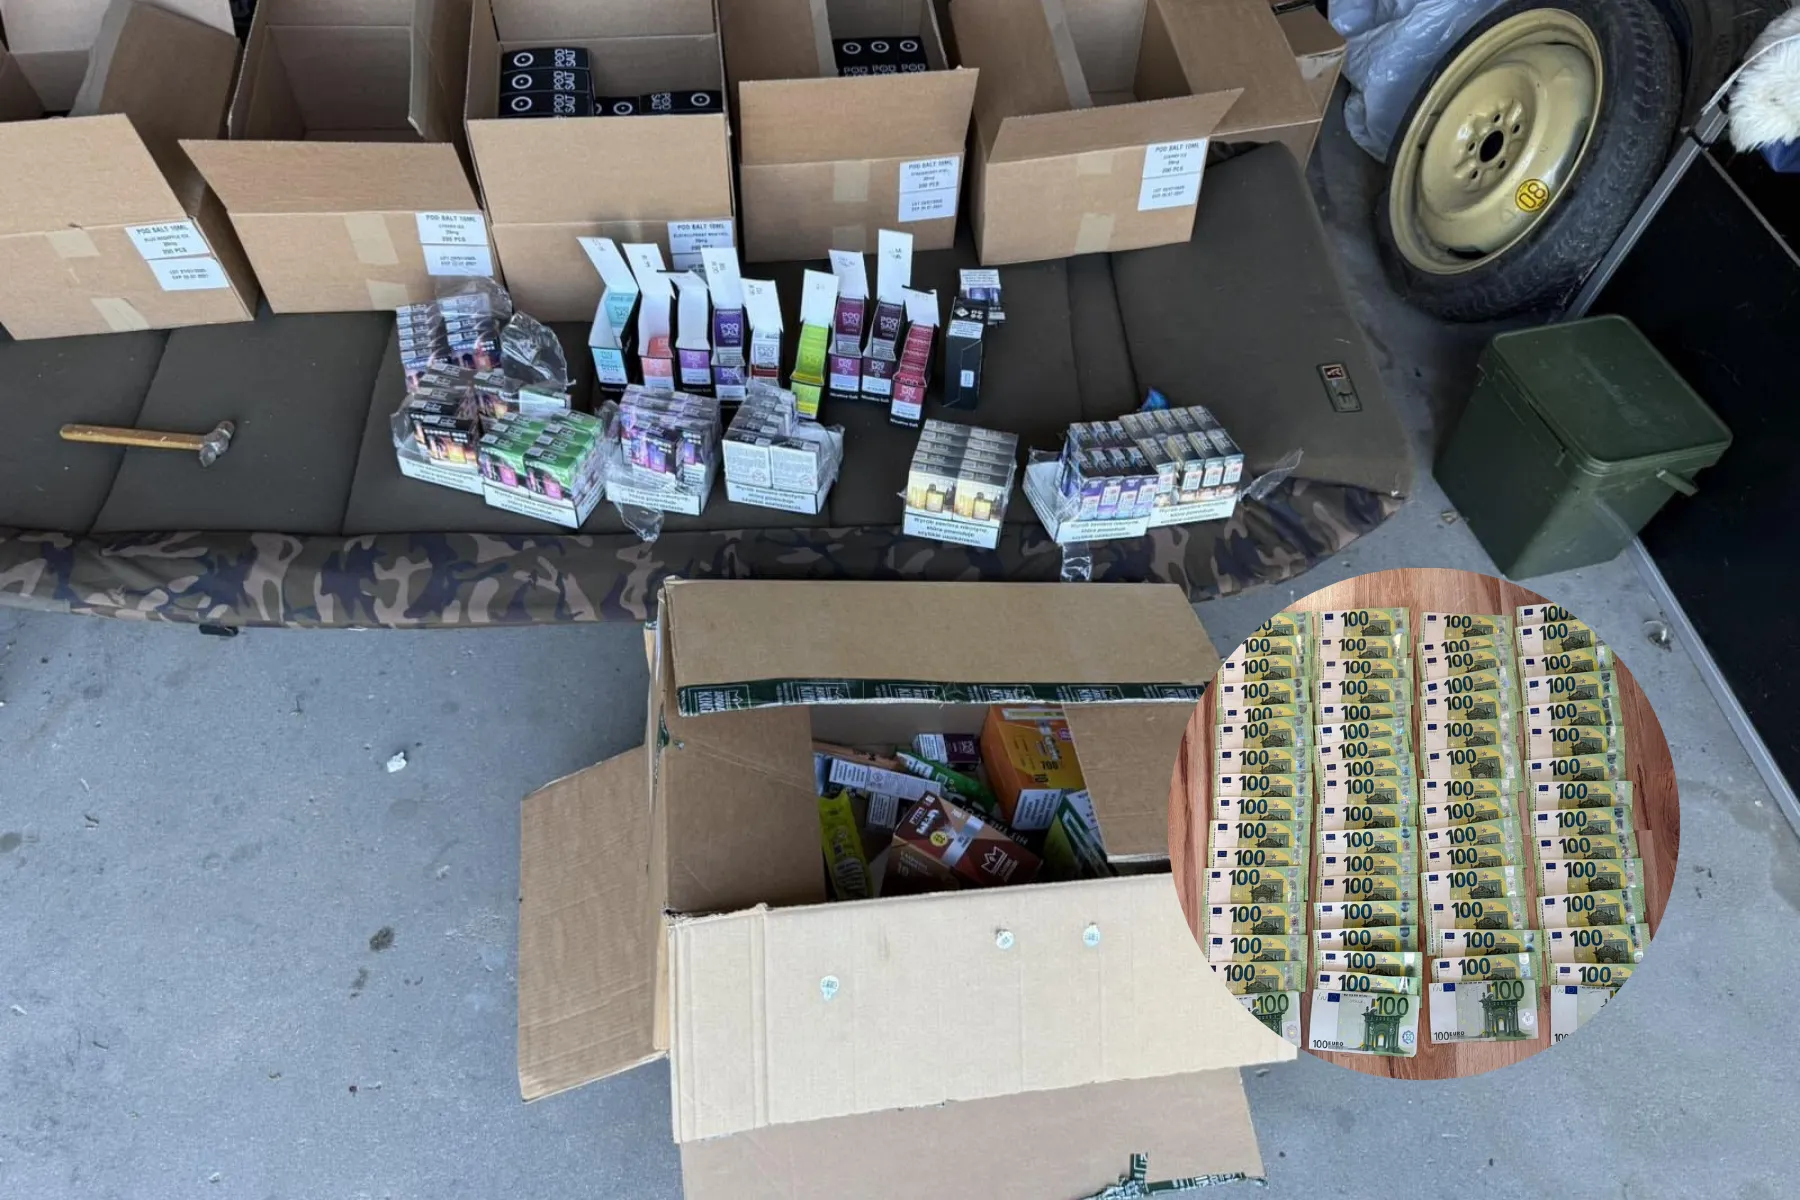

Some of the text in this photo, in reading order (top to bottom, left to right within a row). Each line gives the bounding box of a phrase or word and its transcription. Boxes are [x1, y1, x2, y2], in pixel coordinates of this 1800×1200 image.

[554, 48, 565, 67] POD
[565, 49, 576, 67] SALT
[553, 70, 564, 90] POD
[564, 71, 575, 90] SALT
[553, 94, 565, 113] POD
[565, 95, 576, 113] SALT
[1340, 611, 1369, 627] 100
[1444, 615, 1472, 628] 100
[1540, 605, 1568, 622] 100
[1539, 623, 1568, 640] 100
[1242, 638, 1270, 653] 100
[1338, 638, 1366, 651] 100
[1441, 640, 1470, 653] 100
[1241, 658, 1270, 675] 100
[1343, 660, 1371, 674] 100
[1444, 653, 1474, 668] 100
[1541, 654, 1570, 670] 100
[1241, 682, 1269, 699] 100
[1339, 680, 1368, 695] 100
[1444, 676, 1473, 694] 100
[1546, 676, 1575, 693] 100
[1444, 695, 1473, 710] 100
[1244, 707, 1273, 722] 100
[1341, 705, 1370, 721] 100
[1547, 703, 1577, 720] 100
[1240, 722, 1269, 739] 100
[1340, 723, 1369, 739] 100
[1444, 722, 1473, 738] 100
[1549, 727, 1580, 743] 100
[1239, 750, 1269, 766] 100
[1338, 741, 1368, 758] 100
[1447, 749, 1476, 765] 100
[1344, 761, 1374, 776] 100
[1549, 758, 1580, 775] 100
[1239, 775, 1270, 792] 100
[1345, 779, 1374, 795] 100
[1444, 780, 1474, 796] 100
[1556, 783, 1588, 799] 100
[1236, 799, 1268, 815] 100
[1343, 806, 1373, 822] 100
[1444, 802, 1474, 819] 100
[1556, 810, 1587, 827] 100
[1236, 822, 1267, 839] 100
[1343, 831, 1373, 847] 100
[1446, 827, 1476, 844] 100
[1559, 838, 1590, 853] 100
[1234, 850, 1265, 866] 100
[1344, 856, 1373, 872] 100
[1446, 848, 1477, 865] 100
[1229, 869, 1260, 886] 100
[1564, 861, 1596, 878] 100
[1342, 878, 1373, 894] 100
[1446, 871, 1477, 888] 100
[1341, 903, 1372, 920] 100
[1451, 902, 1483, 918] 100
[1563, 895, 1595, 912] 100
[1230, 905, 1261, 923] 100
[1230, 937, 1262, 954] 100
[1339, 930, 1371, 946] 100
[1463, 931, 1495, 948] 100
[1570, 929, 1603, 947] 100
[1344, 952, 1376, 969] 100
[1458, 958, 1490, 975] 100
[1224, 964, 1255, 982] 100
[1579, 966, 1611, 982] 100
[1338, 974, 1370, 991] 100
[1492, 981, 1524, 999] 100
[1257, 994, 1289, 1013] 100
[1376, 997, 1409, 1016] 100
[1312, 1040, 1328, 1049] 100
[1433, 1032, 1449, 1041] 100
